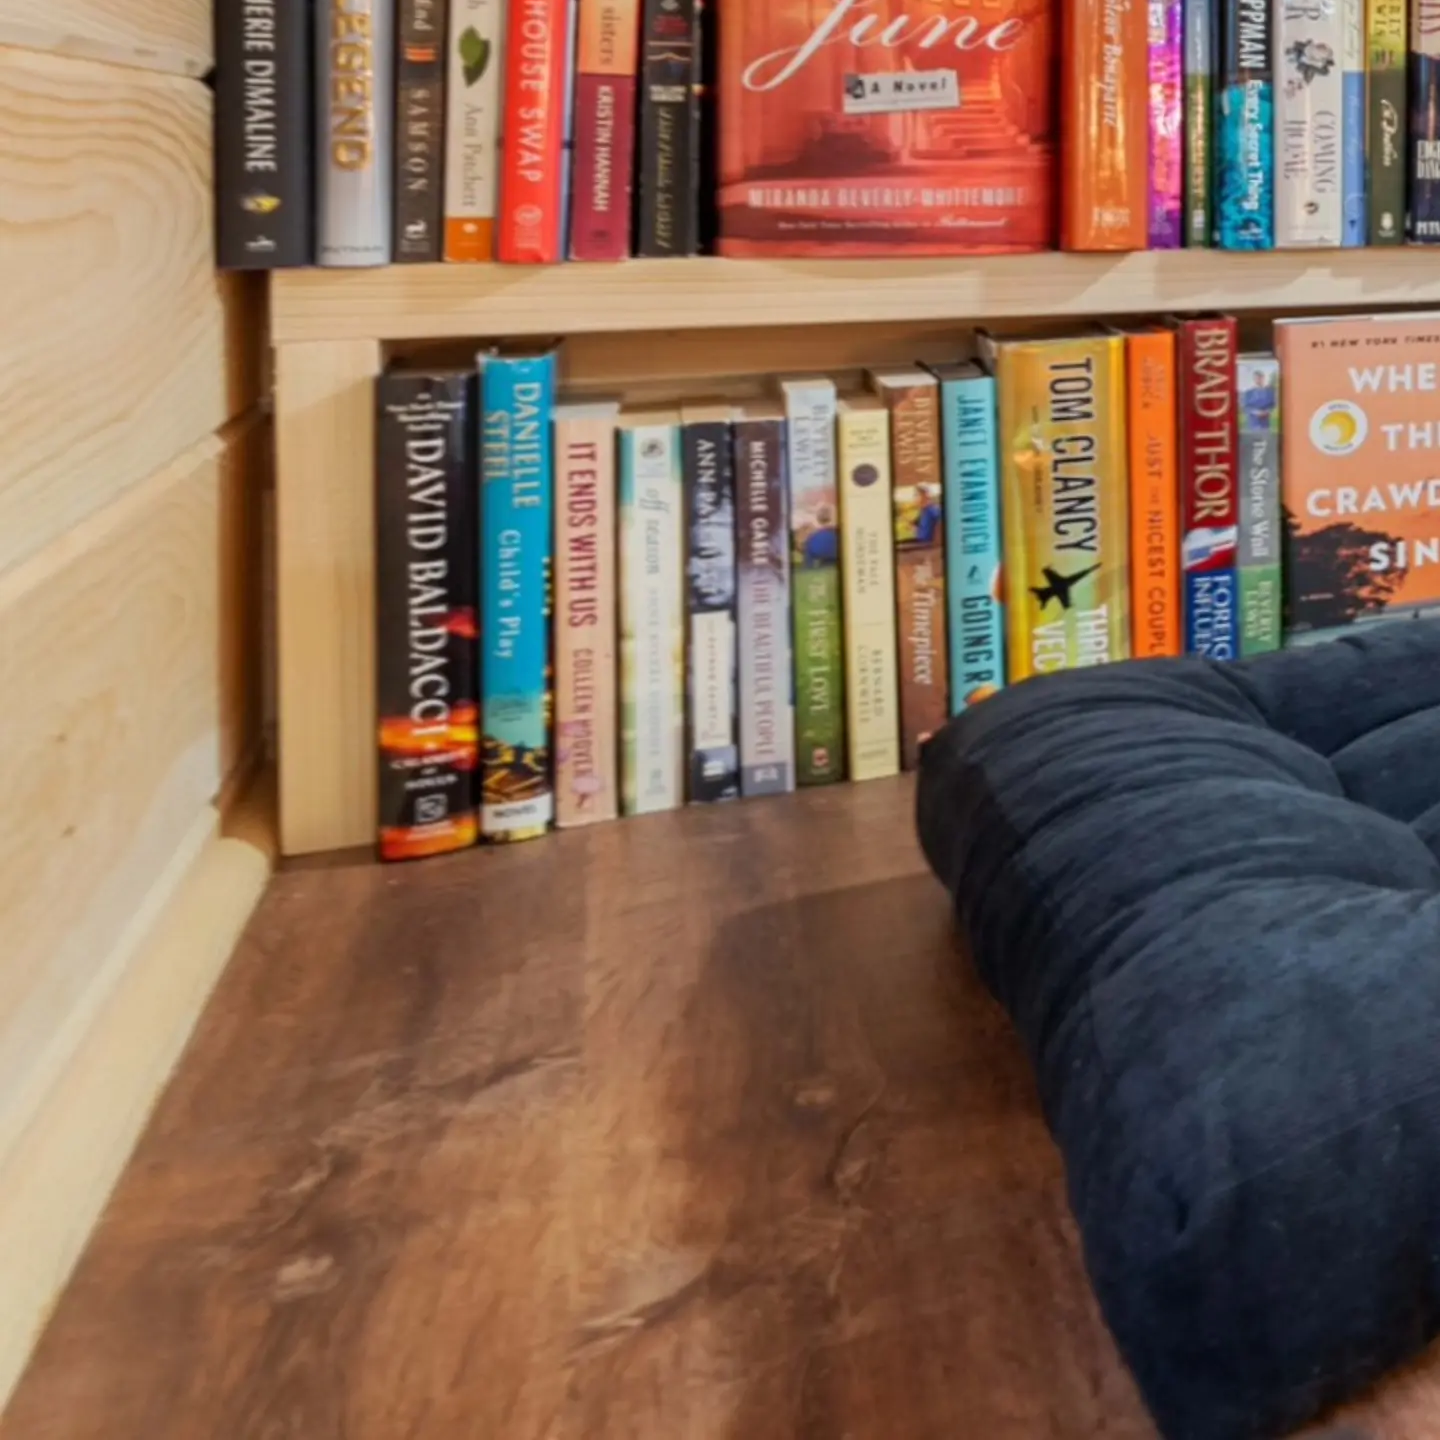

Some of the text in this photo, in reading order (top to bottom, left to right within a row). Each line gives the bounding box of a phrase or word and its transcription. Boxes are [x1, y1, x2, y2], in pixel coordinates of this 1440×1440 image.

[521, 0, 550, 92] HOUSE
[599, 4, 619, 68] sisters
[242, 60, 277, 173] DIMALINE
[893, 76, 949, 96] Novel
[1101, 44, 1125, 128] Bonaparte
[405, 87, 430, 193] SAMSON
[461, 101, 484, 209] Ann Patchett
[516, 106, 547, 185] SWAP
[592, 84, 615, 213] KRISTIN HANNAH
[1241, 78, 1265, 212] Every Secret Thing
[1283, 118, 1308, 180] HOME
[1312, 110, 1337, 195] COMING
[747, 187, 832, 209] MIRANDA
[913, 396, 932, 473] BEVERLY
[1048, 358, 1093, 424] TOM
[1193, 327, 1232, 524] BRAD THOR
[511, 381, 542, 509] DANIELLE
[695, 438, 716, 484] ANN
[811, 403, 829, 479] BEVERLY
[957, 395, 991, 556] JANET EVANOVICH
[1145, 433, 1162, 478] JUST
[405, 438, 448, 549] DAVID
[566, 442, 598, 628] IT ENDS WITH US
[637, 486, 673, 515] off
[749, 440, 772, 566] MICHELLE GABLE
[1050, 434, 1098, 553] CLANCY
[1248, 440, 1268, 558] The Stone Wall
[645, 519, 663, 576] season
[1146, 508, 1166, 580] NICEST
[492, 528, 523, 660] Child's Play
[907, 588, 938, 686] Timepiece
[960, 594, 993, 664] GOING
[1147, 587, 1168, 659] COUPL
[1212, 574, 1234, 662] FOREIG
[407, 559, 451, 738] BALDACCI
[570, 648, 594, 714] COLLEEN
[753, 610, 777, 757] BEAUTIFUL PEOPLE
[807, 608, 830, 714] FIRST LOVE
